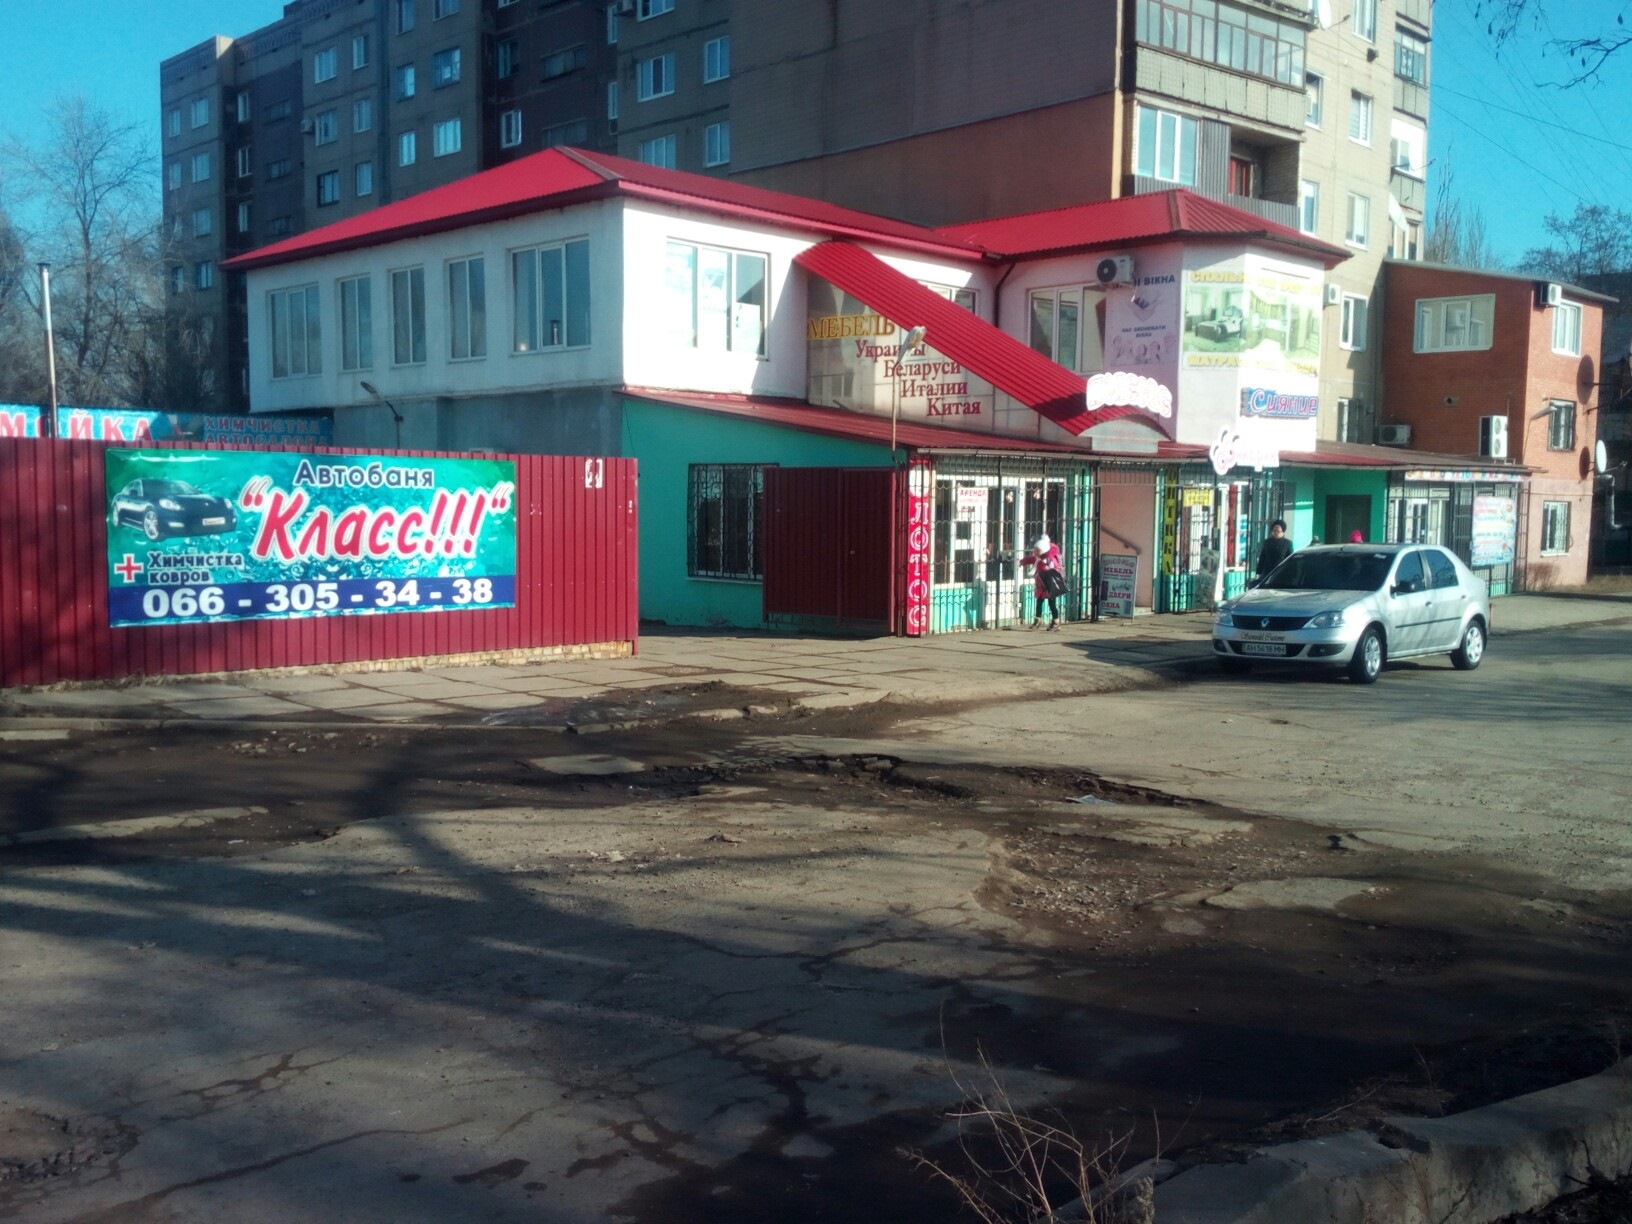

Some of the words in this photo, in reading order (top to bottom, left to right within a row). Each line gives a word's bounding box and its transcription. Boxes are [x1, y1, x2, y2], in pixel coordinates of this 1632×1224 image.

[1144, 274, 1176, 287] ВІКНА
[808, 315, 895, 340] МЕБЕЛЬ
[855, 338, 926, 363] Украиы
[883, 360, 962, 381] Беларуси
[901, 380, 969, 399] Италии
[926, 398, 981, 417] Китая
[1250, 388, 1319, 416] Сияние
[203, 415, 321, 435] ХИМЧИСТКА
[294, 460, 434, 488] Автобаня
[959, 489, 987, 497] АРЕНДА
[149, 553, 243, 568] Химчистка
[908, 502, 929, 627] ЛОТОС
[149, 570, 210, 585] ковров
[1103, 566, 1134, 575] МЕБЕЛЬ
[143, 586, 225, 618] 066
[265, 582, 339, 612] 305
[375, 579, 421, 607] 34
[452, 578, 493, 605] 38
[1109, 591, 1132, 599] ДВЕРИ
[1101, 601, 1121, 609] ОКНА
